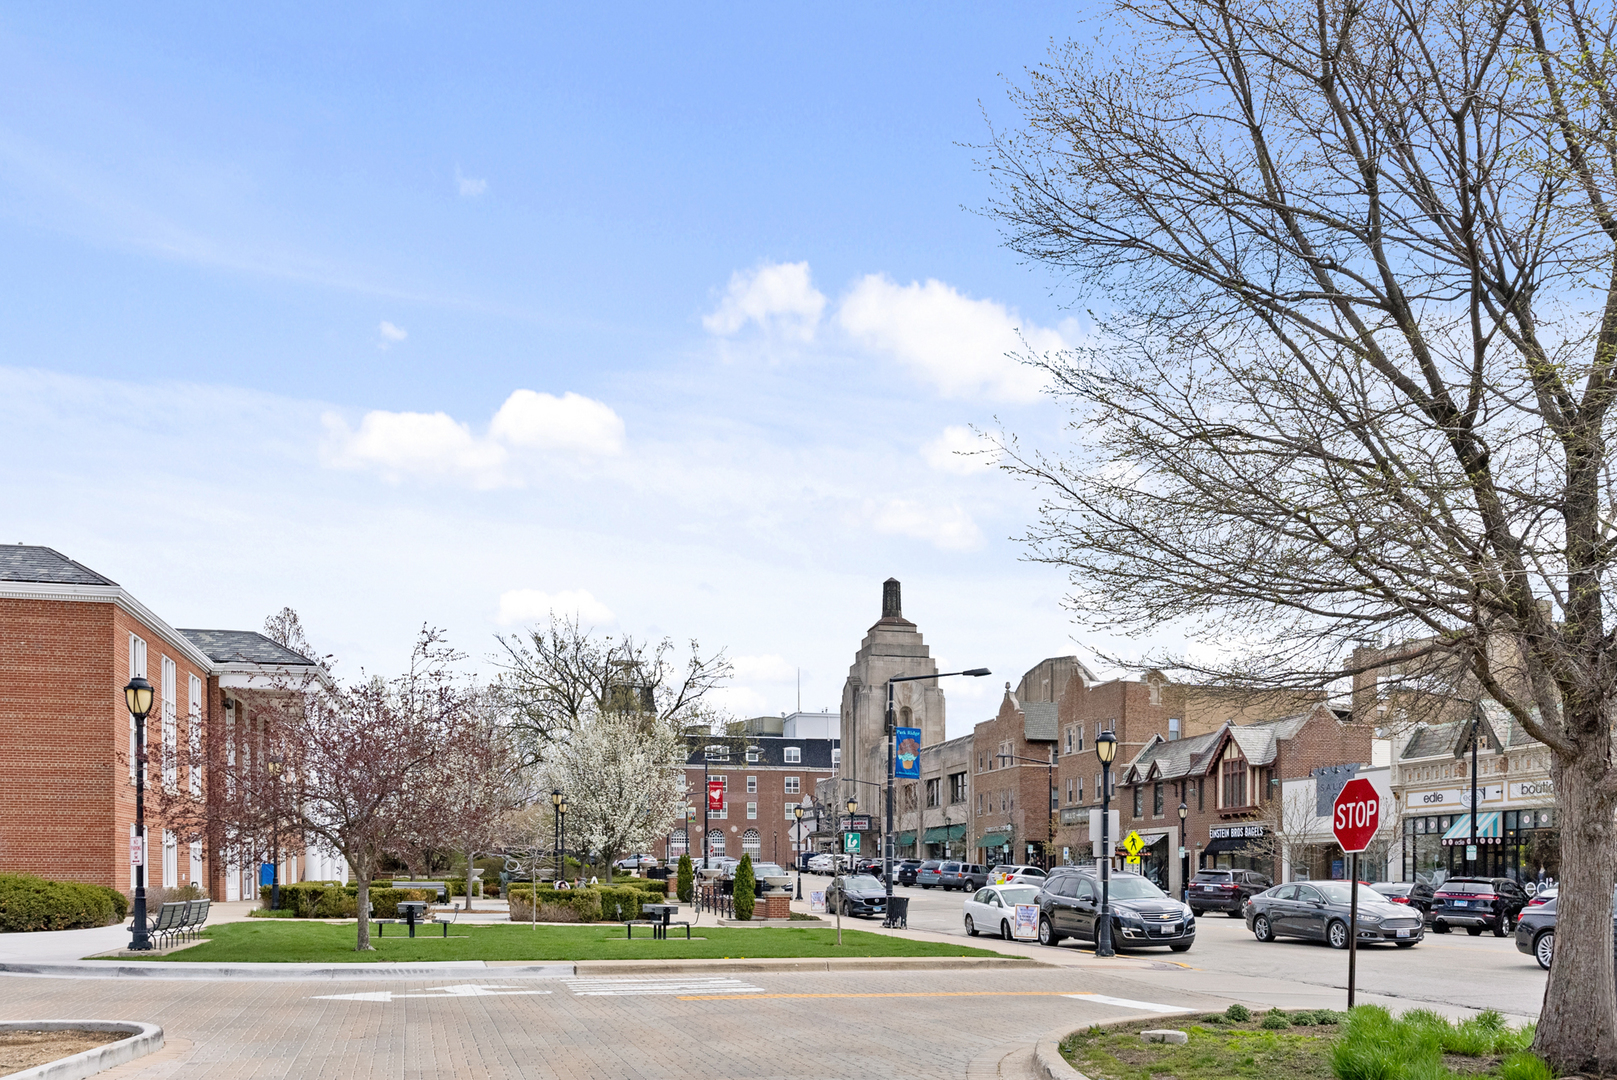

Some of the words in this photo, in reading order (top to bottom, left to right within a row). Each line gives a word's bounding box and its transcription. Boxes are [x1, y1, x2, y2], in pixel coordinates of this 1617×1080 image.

[1320, 781, 1344, 792] SALO
[1423, 791, 1444, 804] edie
[1335, 799, 1377, 830] STOP
[1209, 828, 1230, 839] EINSTEIN
[1230, 827, 1244, 838] BROS
[1244, 826, 1264, 837] BAGELS
[1525, 877, 1559, 897] edi
